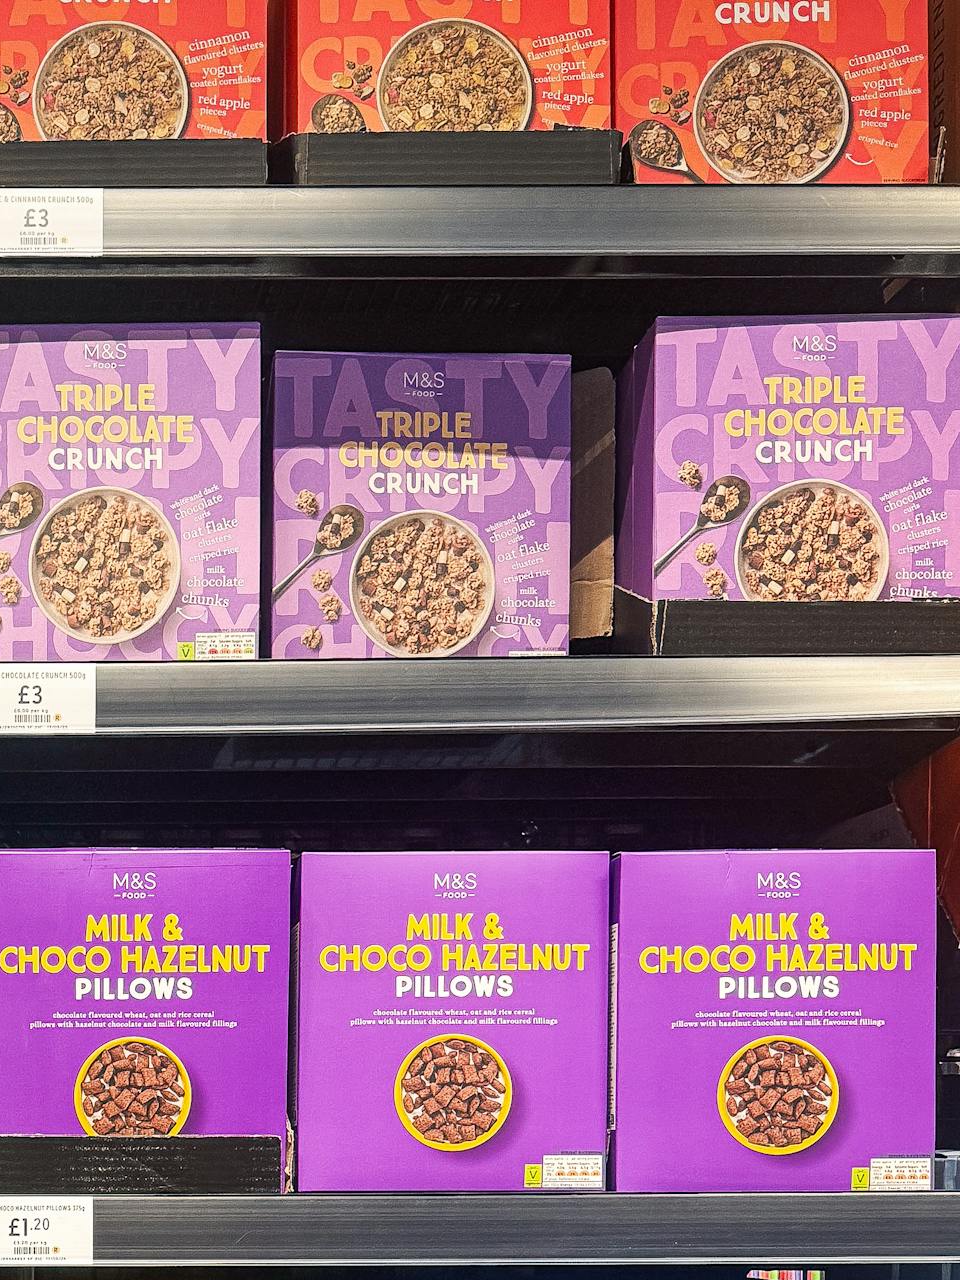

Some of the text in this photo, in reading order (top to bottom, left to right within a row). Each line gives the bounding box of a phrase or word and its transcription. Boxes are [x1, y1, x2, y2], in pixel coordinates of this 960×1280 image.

[715, 0, 830, 24] CRUNCH
[188, 30, 250, 51] cinnamon
[183, 39, 264, 65] flavoured clusters
[202, 63, 243, 80] yogurt
[198, 94, 250, 110] red apple
[24, 208, 49, 228] £3
[84, 343, 127, 360] M&S
[793, 336, 836, 351] M&S
[56, 385, 155, 411] TRIPLE
[764, 376, 865, 404] TRIPLE
[17, 416, 194, 443] CHOCOLATE
[724, 407, 904, 437] CHOCOLATE
[48, 449, 163, 470] CRUNCH
[756, 440, 873, 463] CRUNCH
[892, 510, 948, 533] oat flake
[187, 576, 245, 587] chocolate
[895, 568, 953, 580] chocolate
[181, 592, 229, 607] chunks
[69, 672, 86, 680] 500g
[18, 685, 43, 704] £3
[113, 873, 156, 890] M&S
[86, 914, 183, 942] MILK &
[730, 912, 829, 941] MILK &
[121, 945, 270, 973] HAZELNUT
[639, 944, 917, 973] CHOCO HAZELNUT
[75, 978, 193, 1000] PILLOWS
[719, 976, 839, 999] PILLOWS
[8, 1218, 50, 1236] £1.20
